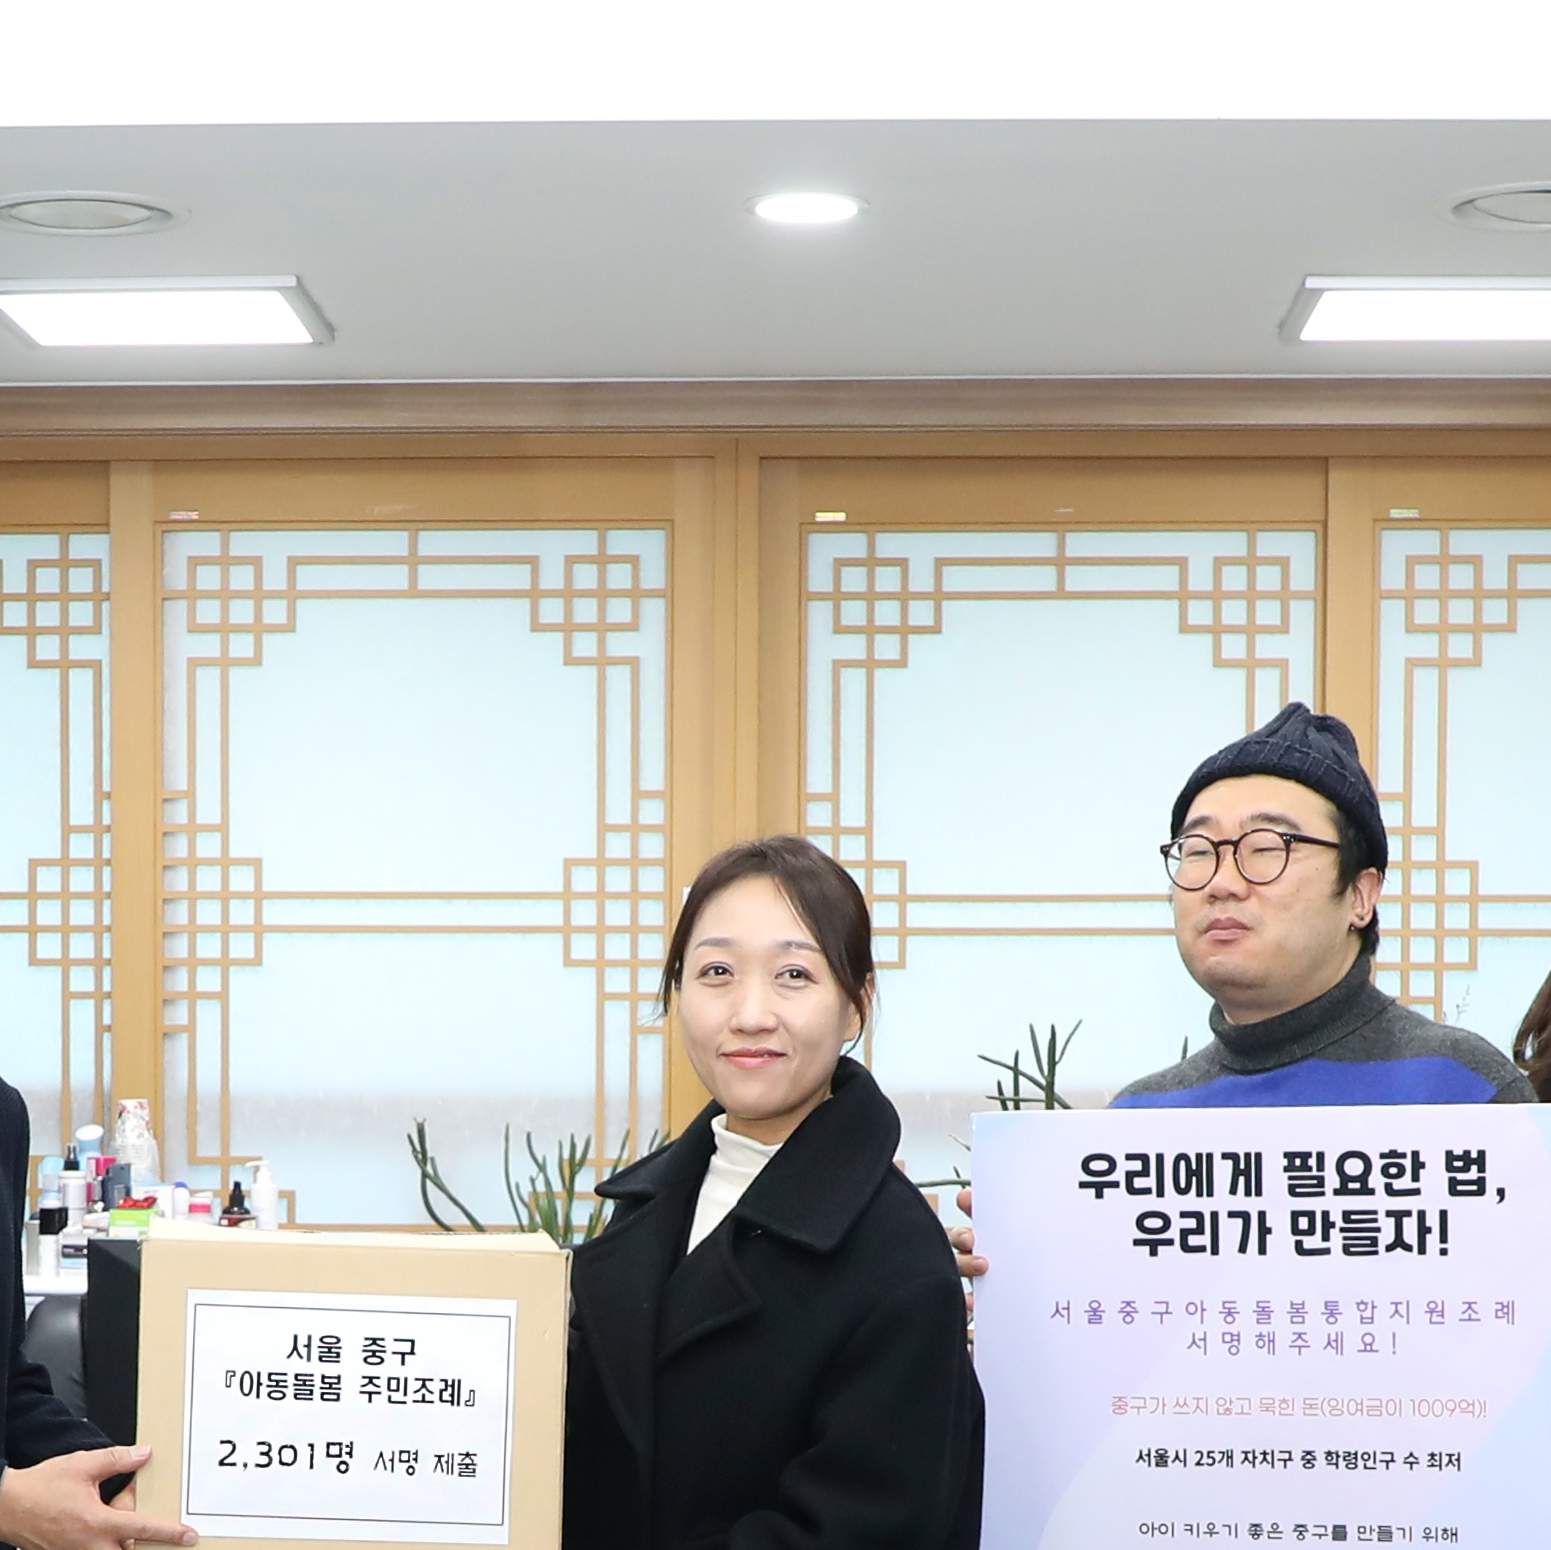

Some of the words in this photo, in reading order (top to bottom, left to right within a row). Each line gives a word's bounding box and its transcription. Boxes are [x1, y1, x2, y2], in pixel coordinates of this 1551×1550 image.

[1079, 1152, 1262, 1199] 우리에게
[1283, 1150, 1425, 1197] 필요한
[1445, 1150, 1505, 1204] 법,
[1133, 1211, 1272, 1257] 우리가
[1291, 1209, 1448, 1256] 만들자!
[287, 1334, 342, 1363] 서울
[362, 1337, 415, 1366] 중구
[1187, 1331, 1396, 1356] 서명해주세요!
[226, 1371, 341, 1402] 『아동돌봄
[359, 1376, 475, 1407] 주민조례』
[1111, 1396, 1166, 1415] 중구가
[1173, 1397, 1208, 1415] 쓰지
[1216, 1397, 1252, 1416] 않고
[1259, 1398, 1294, 1416] 묵힌
[1302, 1397, 1402, 1417] 돈(잉여금이
[1410, 1399, 1486, 1418] 1009억)!
[219, 1440, 353, 1474] 2,301명
[374, 1450, 418, 1476] 서명
[434, 1452, 477, 1477] 제출
[1136, 1448, 1186, 1467] 서울시
[1195, 1449, 1233, 1468] 25개
[1241, 1449, 1293, 1468] 자치구
[1301, 1451, 1317, 1469] 중
[1324, 1450, 1396, 1470] 학령인구
[1403, 1452, 1419, 1470] 수
[1427, 1452, 1460, 1471] 최저
[1139, 1522, 1174, 1537] 아이
[1184, 1522, 1238, 1538] 키우기
[1248, 1523, 1283, 1540] 좋은
[1293, 1524, 1348, 1541] 중구를
[1358, 1525, 1412, 1542] 만들기
[1422, 1527, 1457, 1543] 위해
